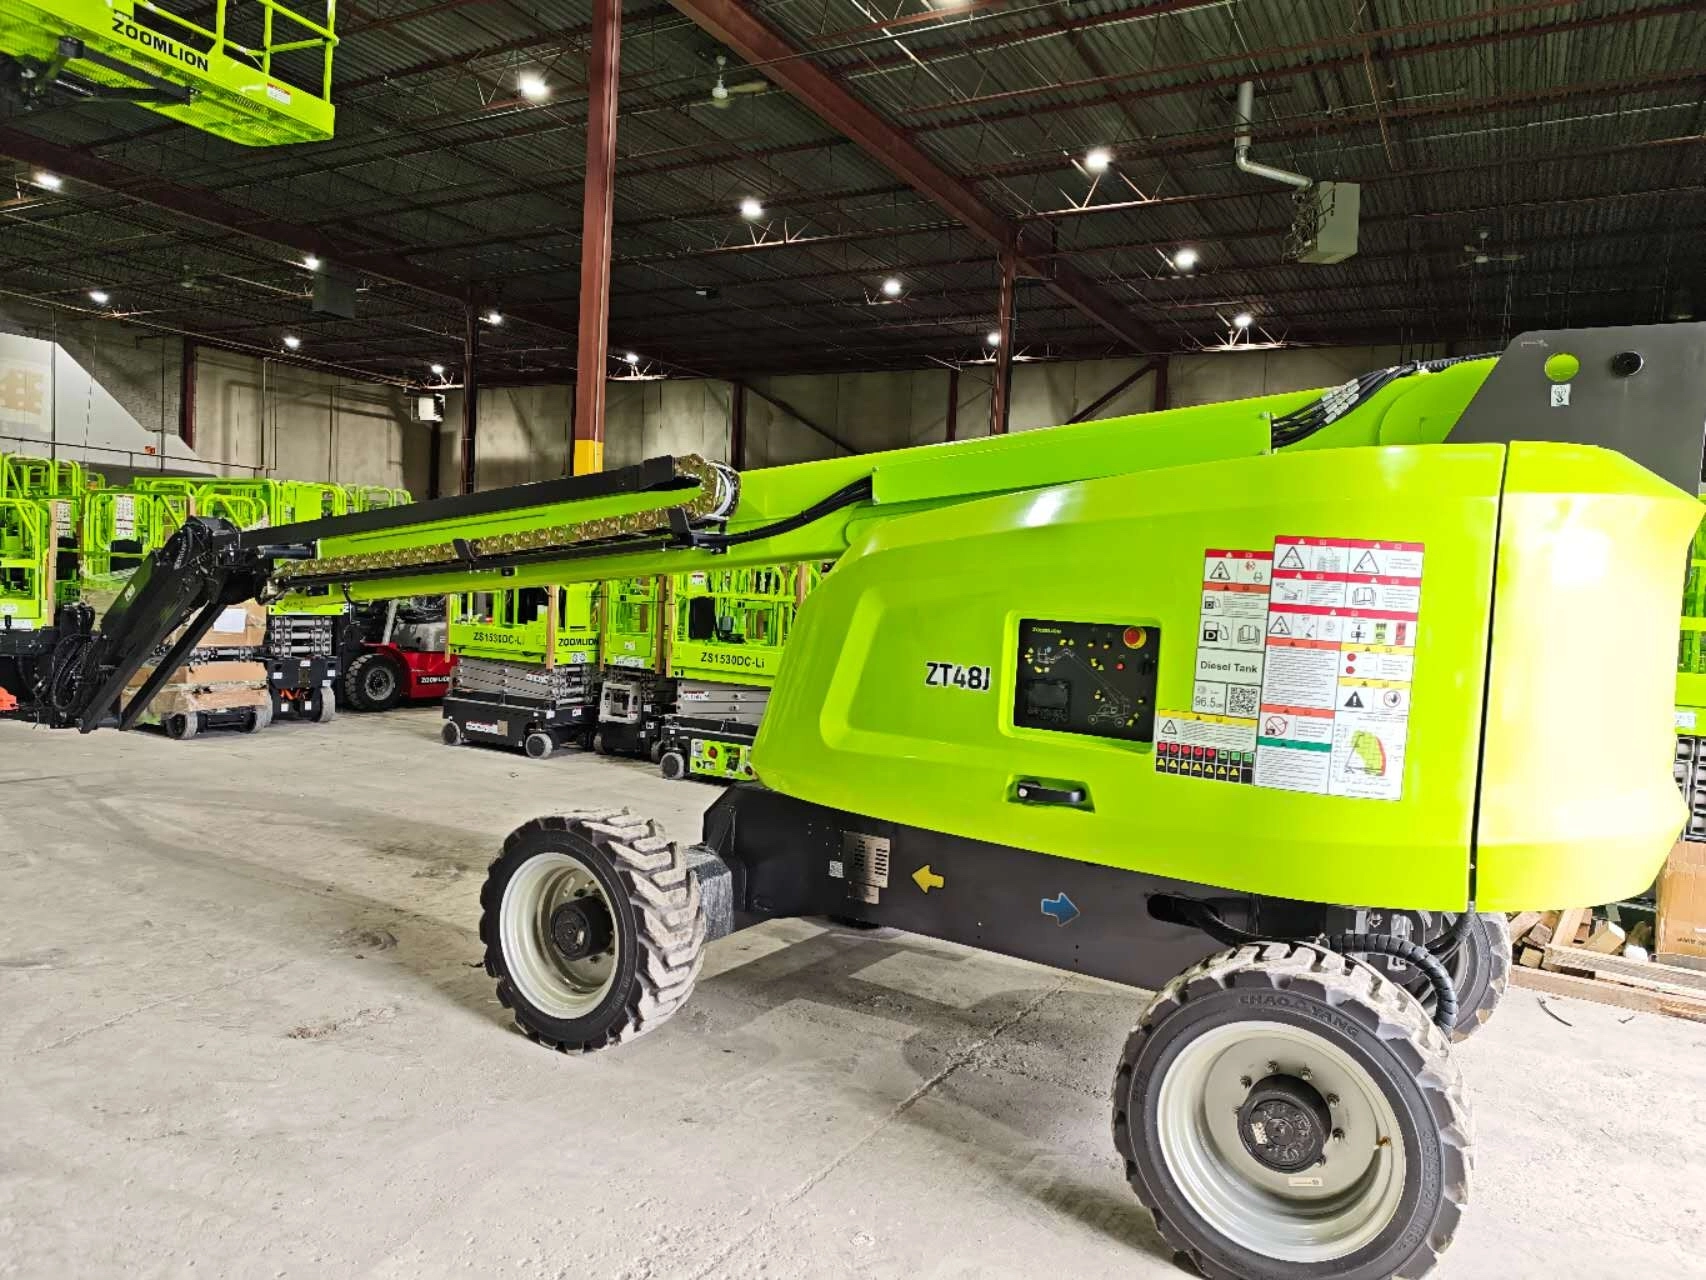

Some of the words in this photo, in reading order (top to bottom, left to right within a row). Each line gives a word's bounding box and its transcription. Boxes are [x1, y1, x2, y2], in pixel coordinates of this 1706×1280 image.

[111, 17, 209, 72] ZOOMLION
[700, 651, 766, 669] ZS1530DC-Li
[1200, 660, 1231, 672] Diesel
[1234, 662, 1258, 674] Tank
[925, 662, 991, 691] ZT48J
